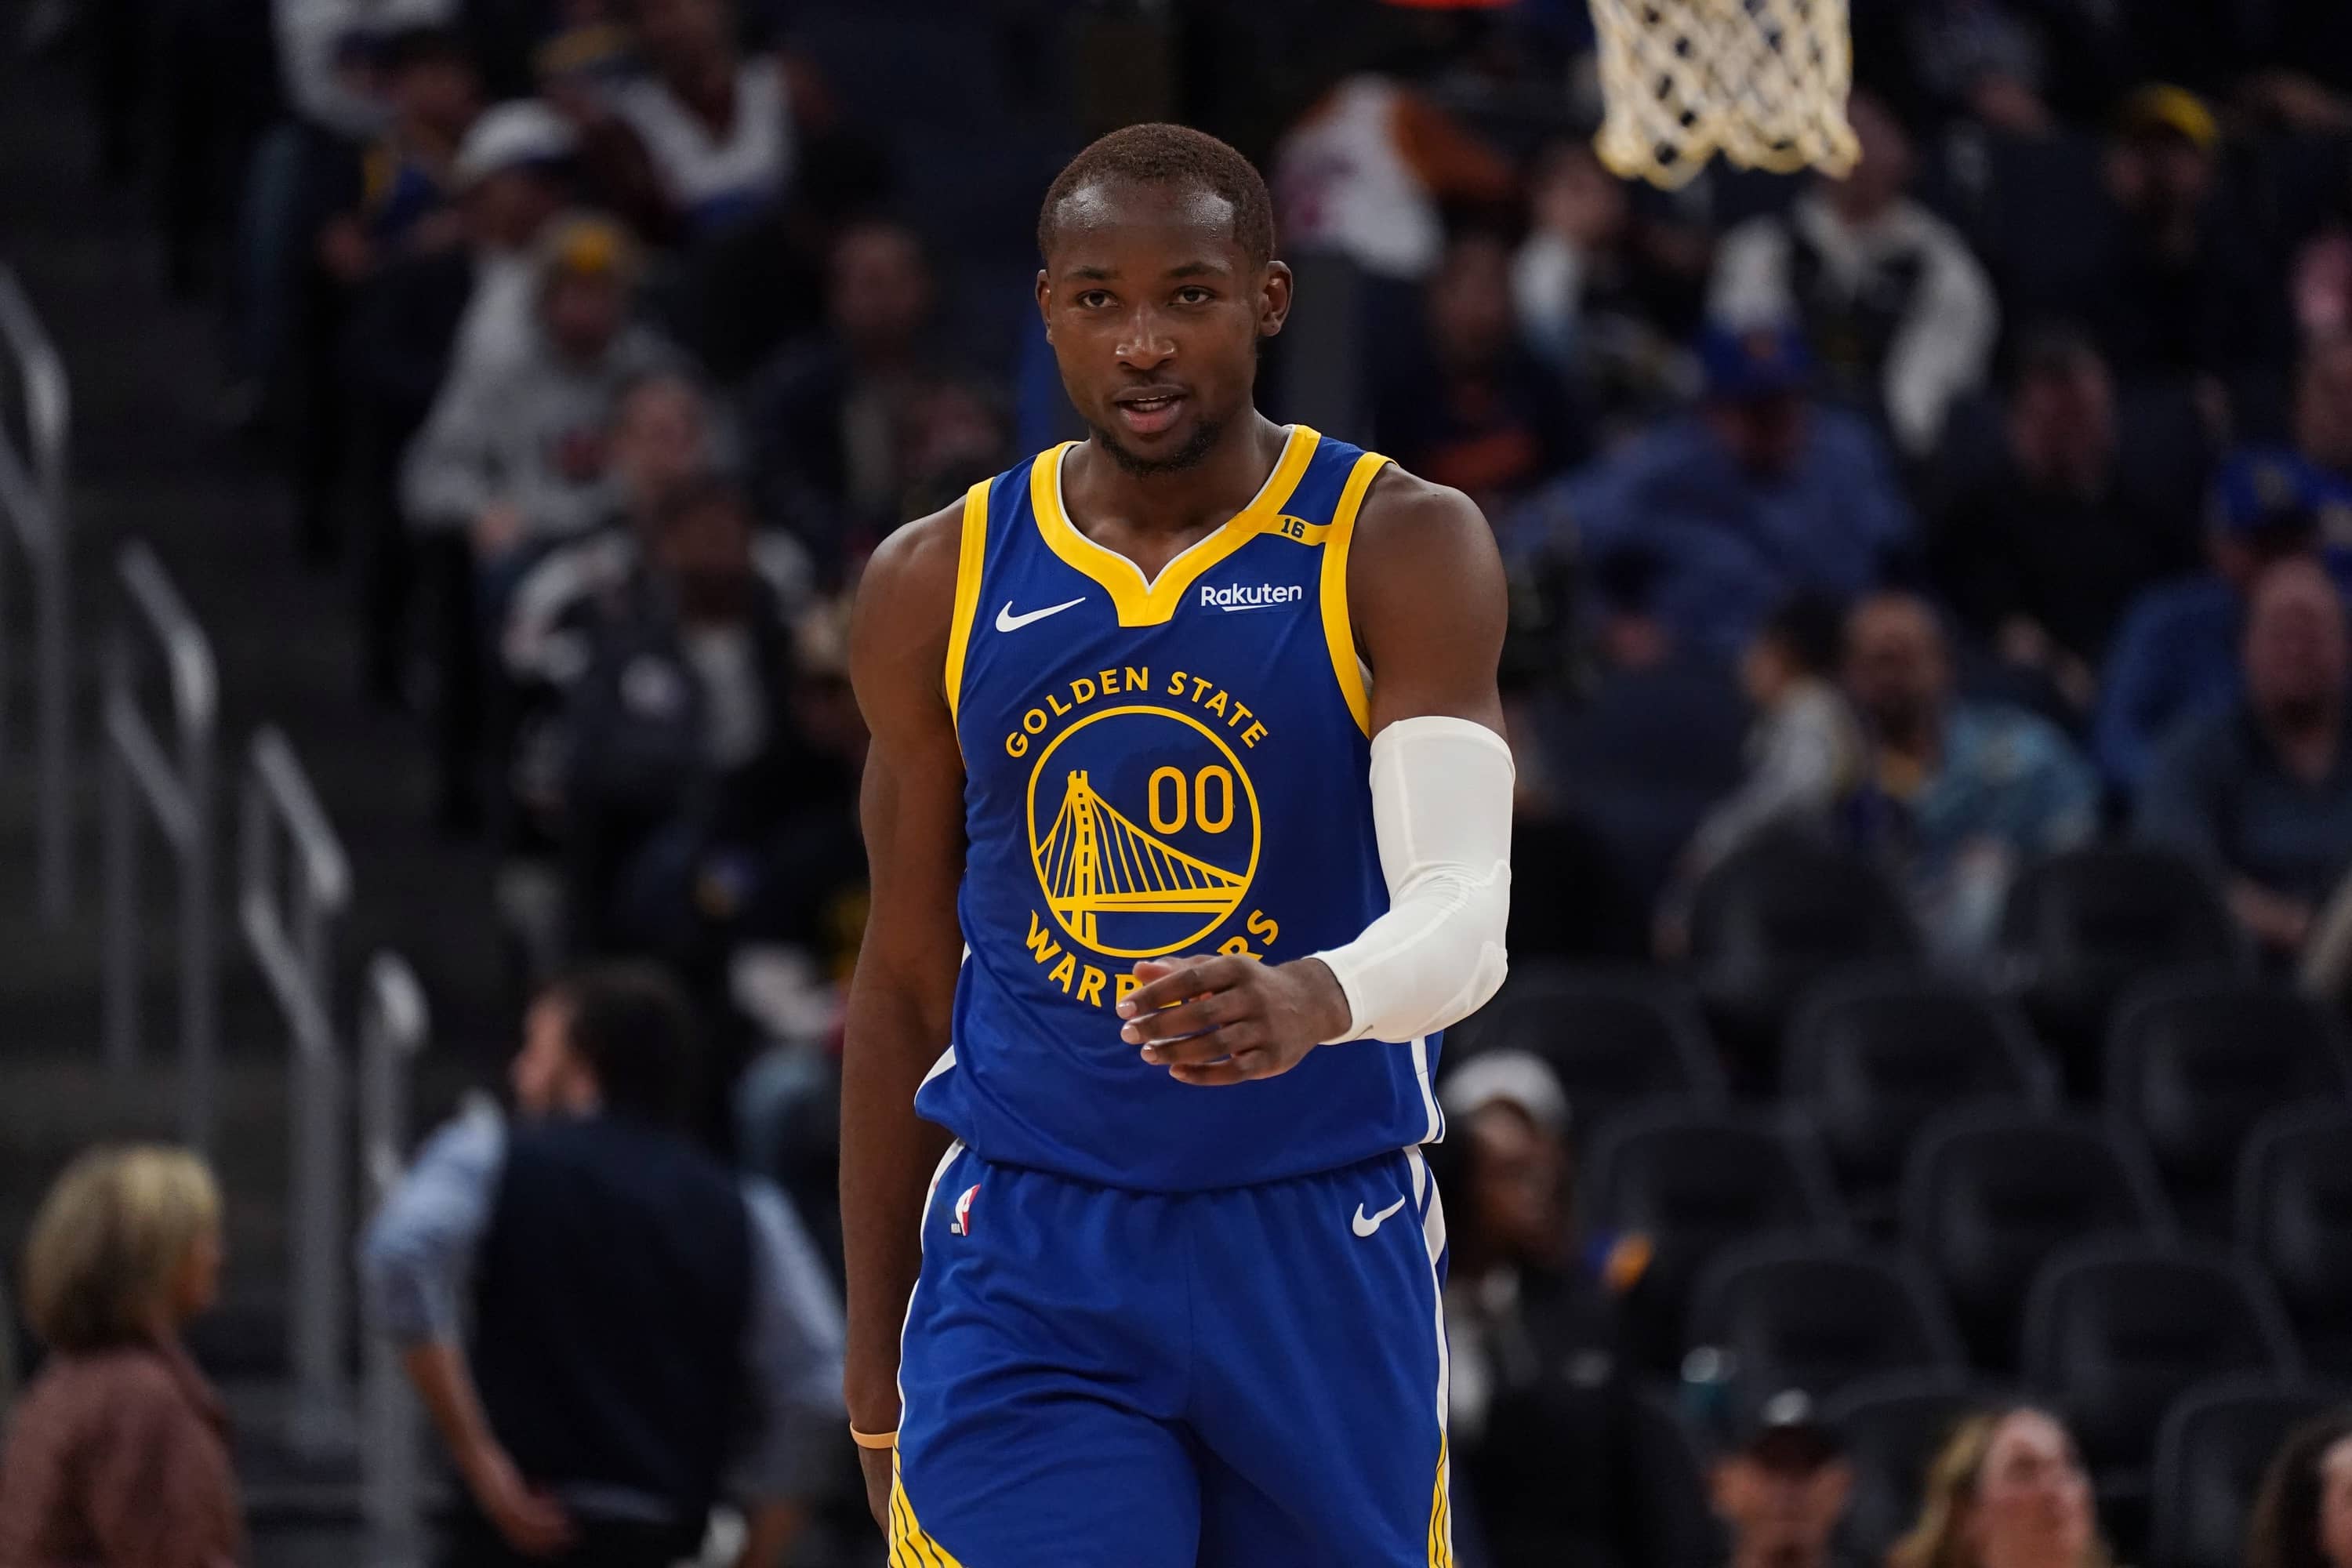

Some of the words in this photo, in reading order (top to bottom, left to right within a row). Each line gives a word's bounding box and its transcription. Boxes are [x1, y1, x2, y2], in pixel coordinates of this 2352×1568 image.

[1281, 518, 1305, 539] 16
[1200, 583, 1303, 608] Rakuten
[1005, 666, 1149, 758] GOLDEN
[1167, 670, 1269, 749] STATE
[1148, 764, 1234, 835] 00
[1025, 908, 1279, 1008] WARRRS
